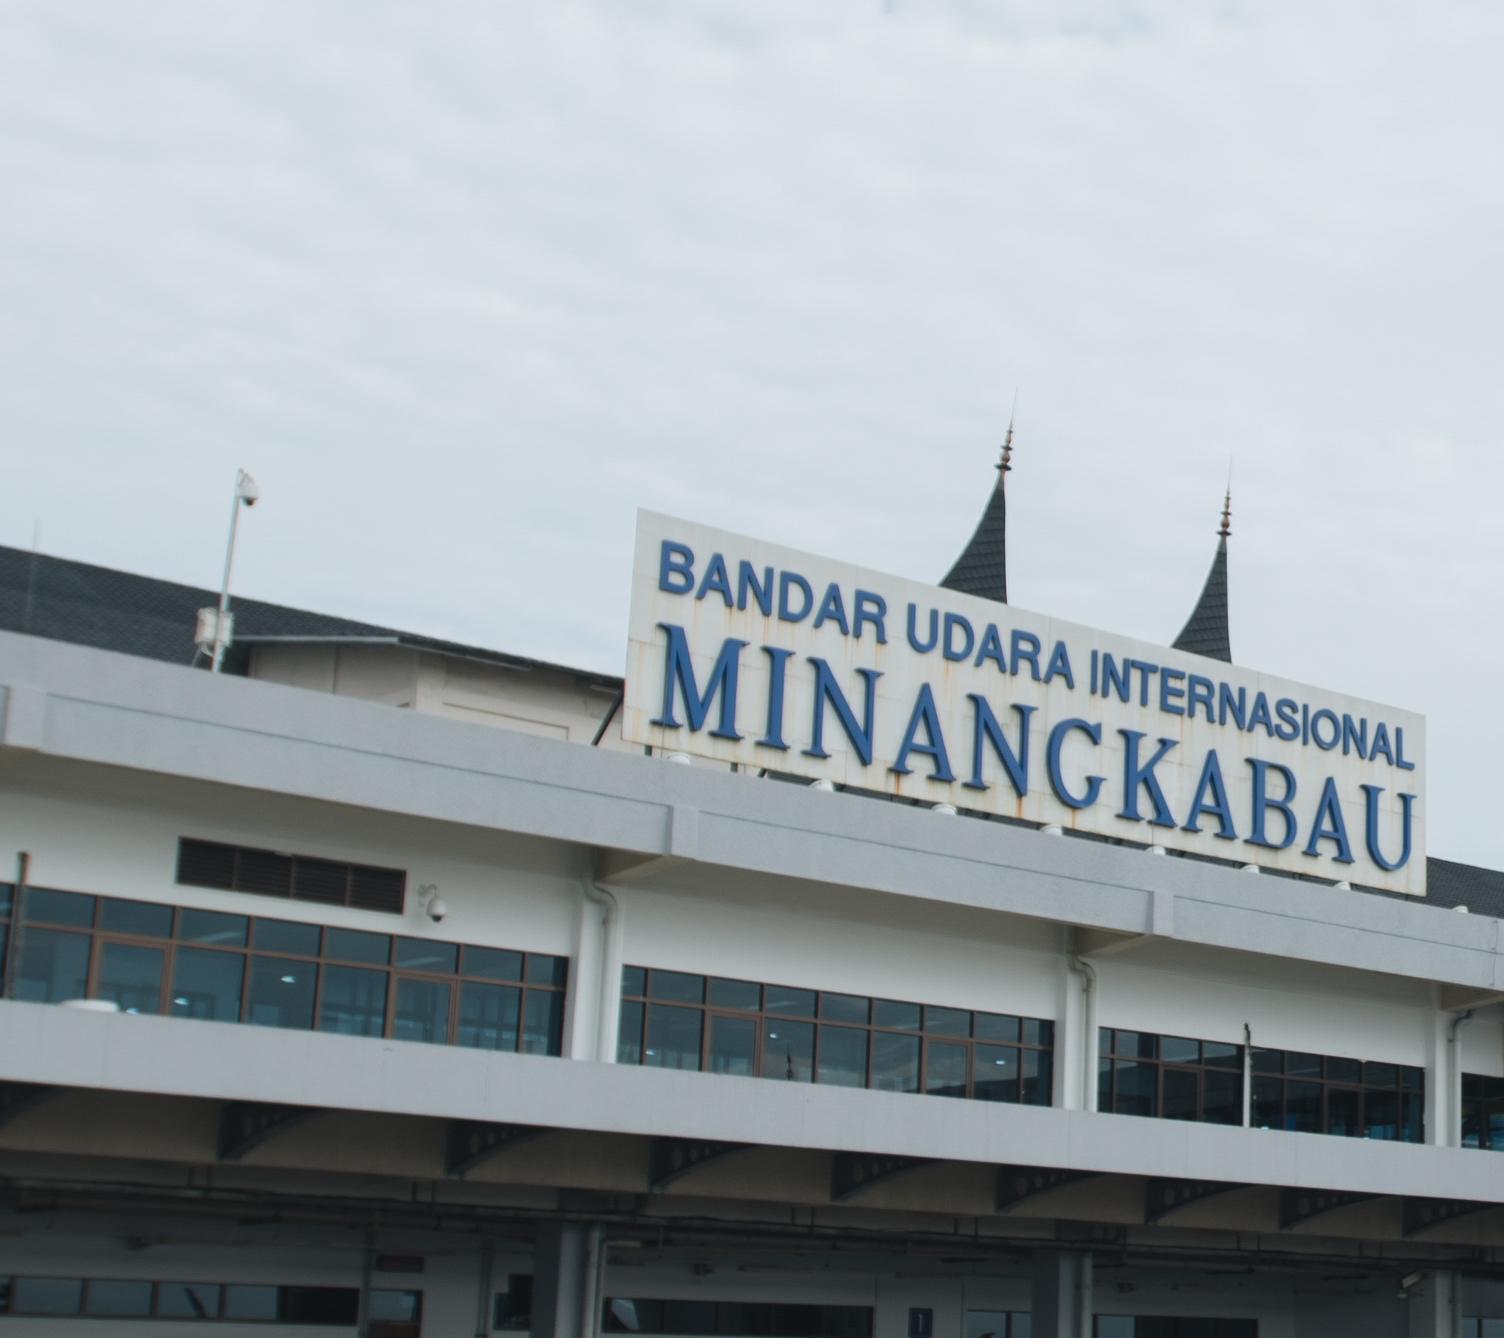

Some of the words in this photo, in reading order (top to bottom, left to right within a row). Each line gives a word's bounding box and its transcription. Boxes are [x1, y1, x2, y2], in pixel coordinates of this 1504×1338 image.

[651, 623, 1416, 871] MINANGKABAU
[659, 539, 888, 643] BANDAR
[906, 602, 1075, 688] UDARA
[1090, 649, 1415, 770] INTERNASIONAL
[917, 1313, 924, 1333] 1
